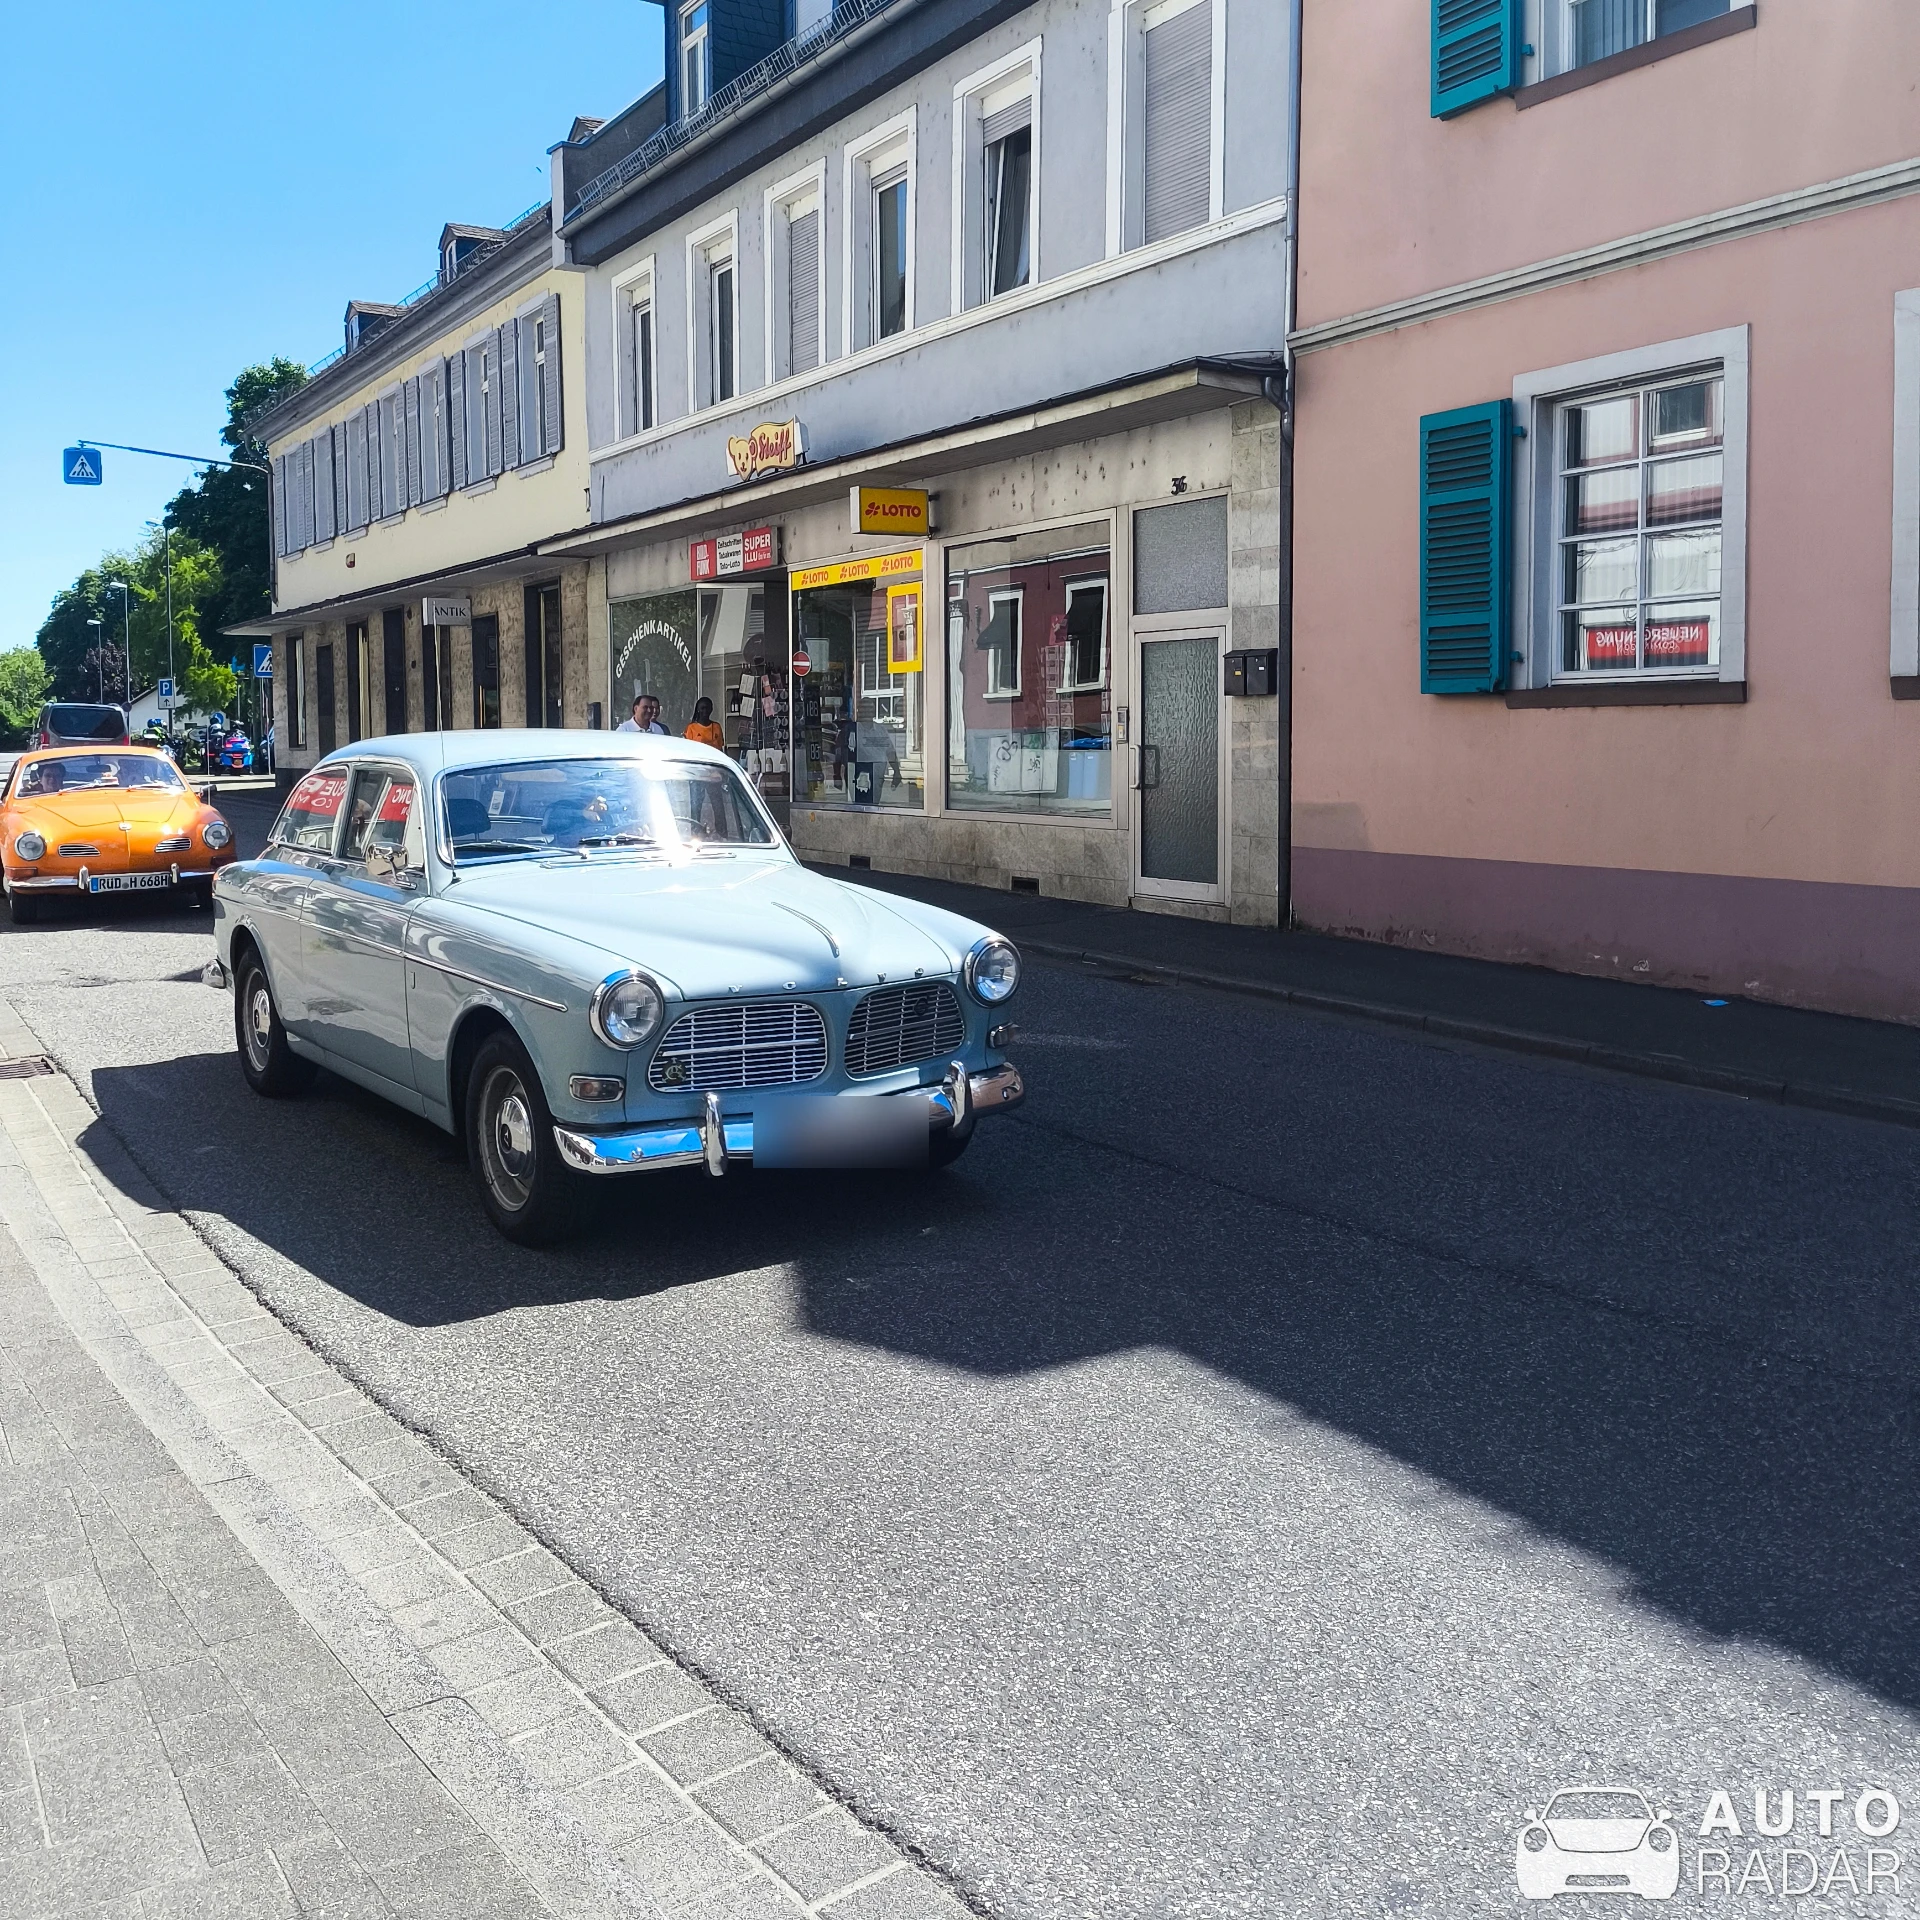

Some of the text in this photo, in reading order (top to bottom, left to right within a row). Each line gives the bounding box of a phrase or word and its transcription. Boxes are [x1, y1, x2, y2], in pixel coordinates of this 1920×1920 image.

[758, 427, 792, 464] Steiff
[1171, 475, 1188, 496] 36
[882, 503, 921, 518] LOTTO
[744, 533, 771, 552] SUPER
[744, 551, 758, 564] ILLU
[809, 555, 914, 584] LOTTO LOTTO LOTTO
[434, 606, 467, 617] ANTIK
[615, 619, 692, 679] GESCHENKARTIKEL
[162, 682, 170, 695] P
[99, 875, 168, 890] RÜD H 668H
